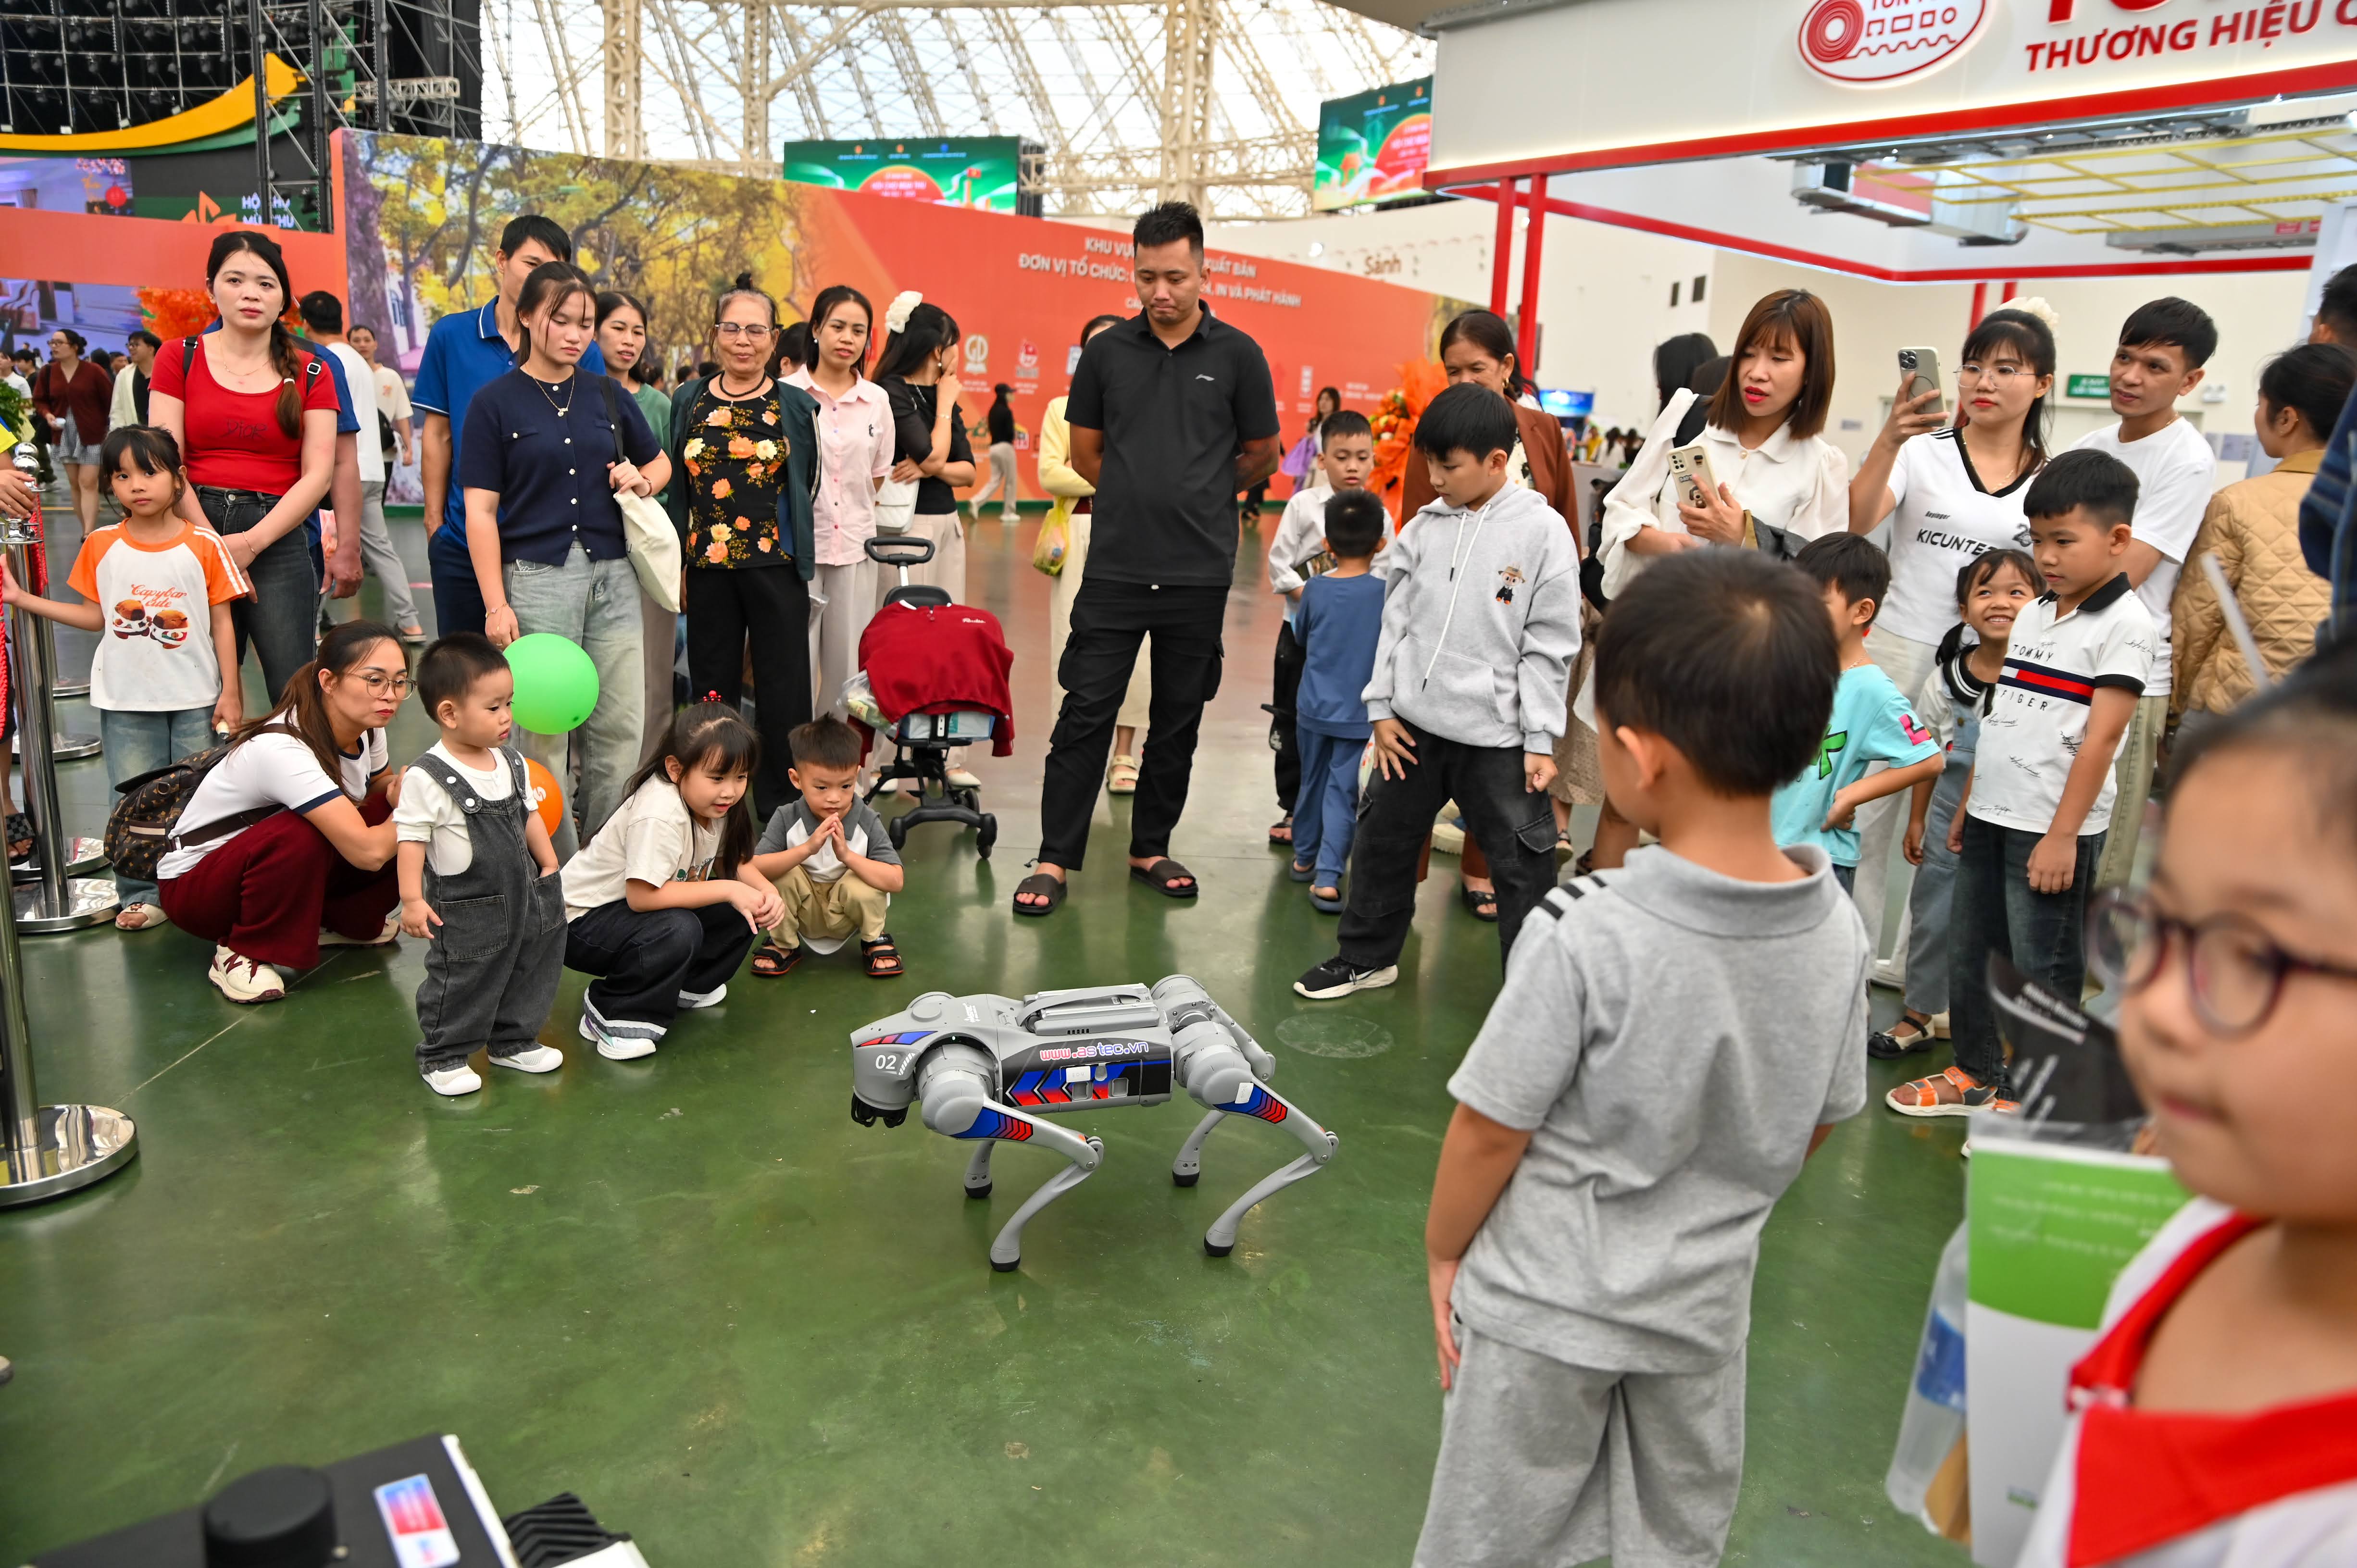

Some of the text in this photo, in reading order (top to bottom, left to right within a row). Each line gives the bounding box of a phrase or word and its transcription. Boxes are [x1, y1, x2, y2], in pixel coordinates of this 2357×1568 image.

[2025, 19, 2198, 72] THƯƠNG
[2208, 0, 2322, 49] HIỆU
[242, 192, 261, 212] HỘ
[1085, 237, 1112, 254] KHU
[1019, 253, 1051, 271] ĐƠN
[1052, 257, 1067, 277] VỊ
[1916, 528, 1997, 556] KICUNTE
[145, 597, 172, 608] cute
[2013, 644, 2054, 662] TOMMY
[875, 1055, 897, 1070] 02
